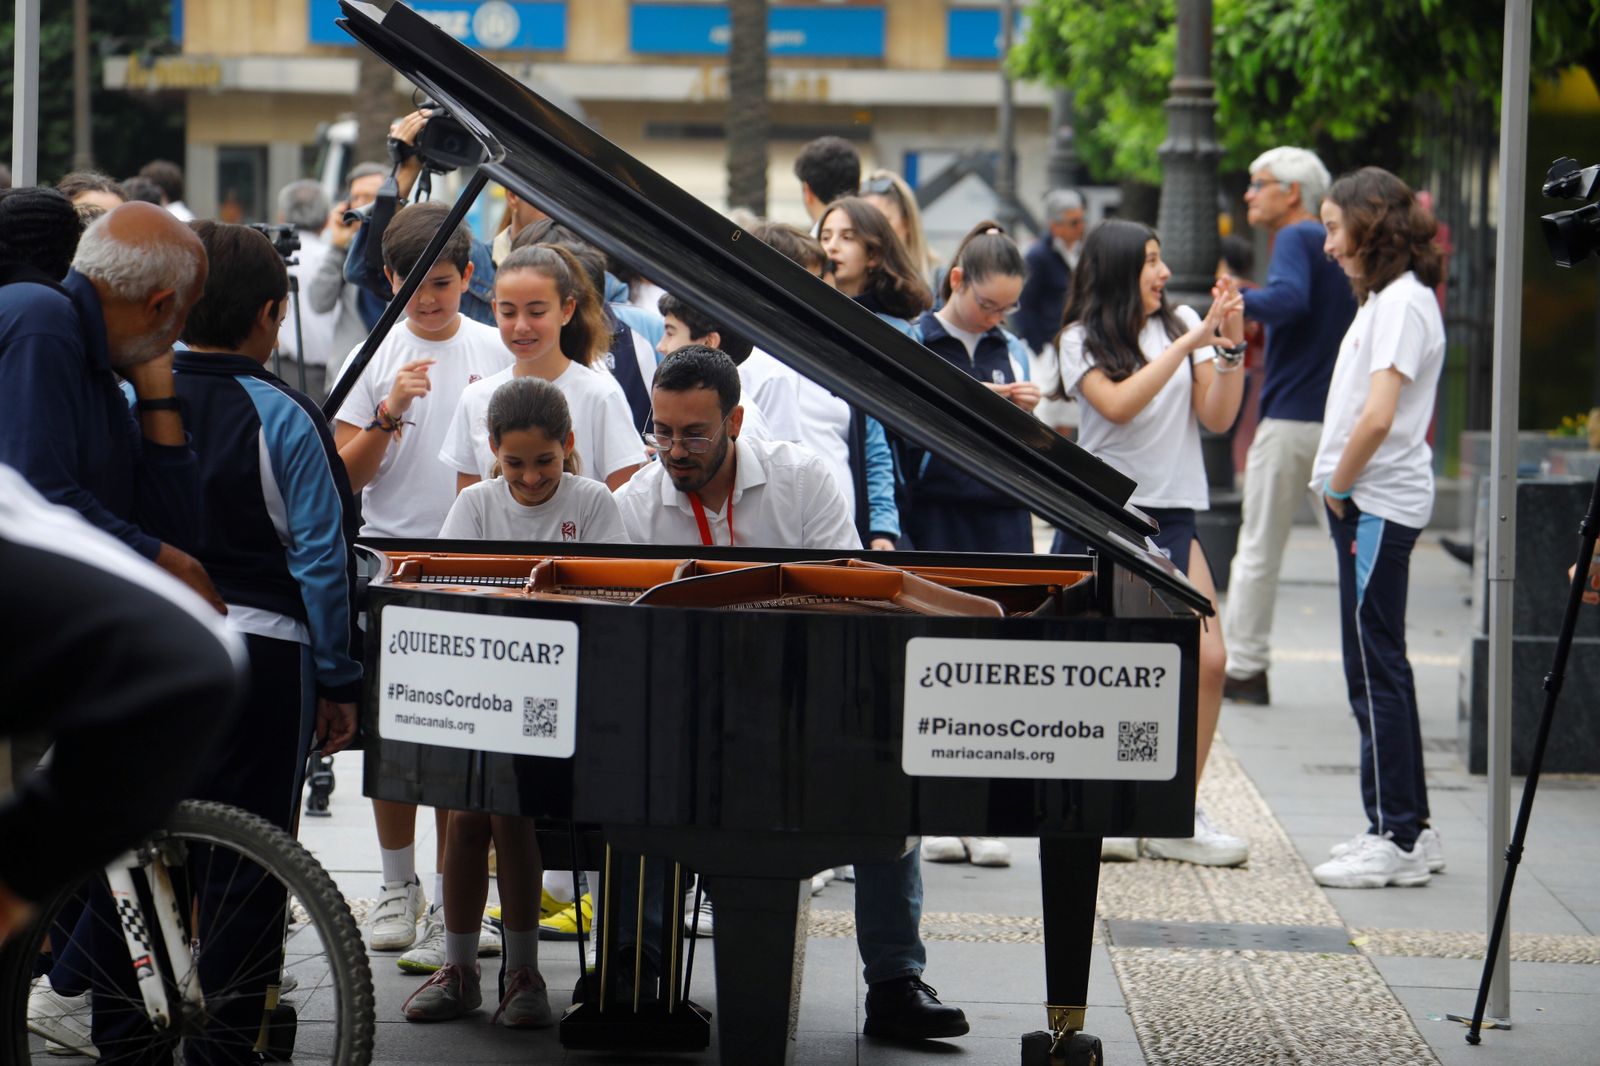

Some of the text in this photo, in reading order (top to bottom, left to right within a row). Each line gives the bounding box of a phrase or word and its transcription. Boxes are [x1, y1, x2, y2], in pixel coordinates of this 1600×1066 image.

[389, 630, 564, 665] ¿QUIERES TOCAR?
[920, 662, 1167, 688] ¿QUIERES TOCAR?
[387, 683, 512, 712] #PianosCordoba
[395, 712, 475, 734] mariacanals.org
[918, 717, 1105, 739] #PianosCordoba
[931, 747, 1056, 764] mariacanals.org
